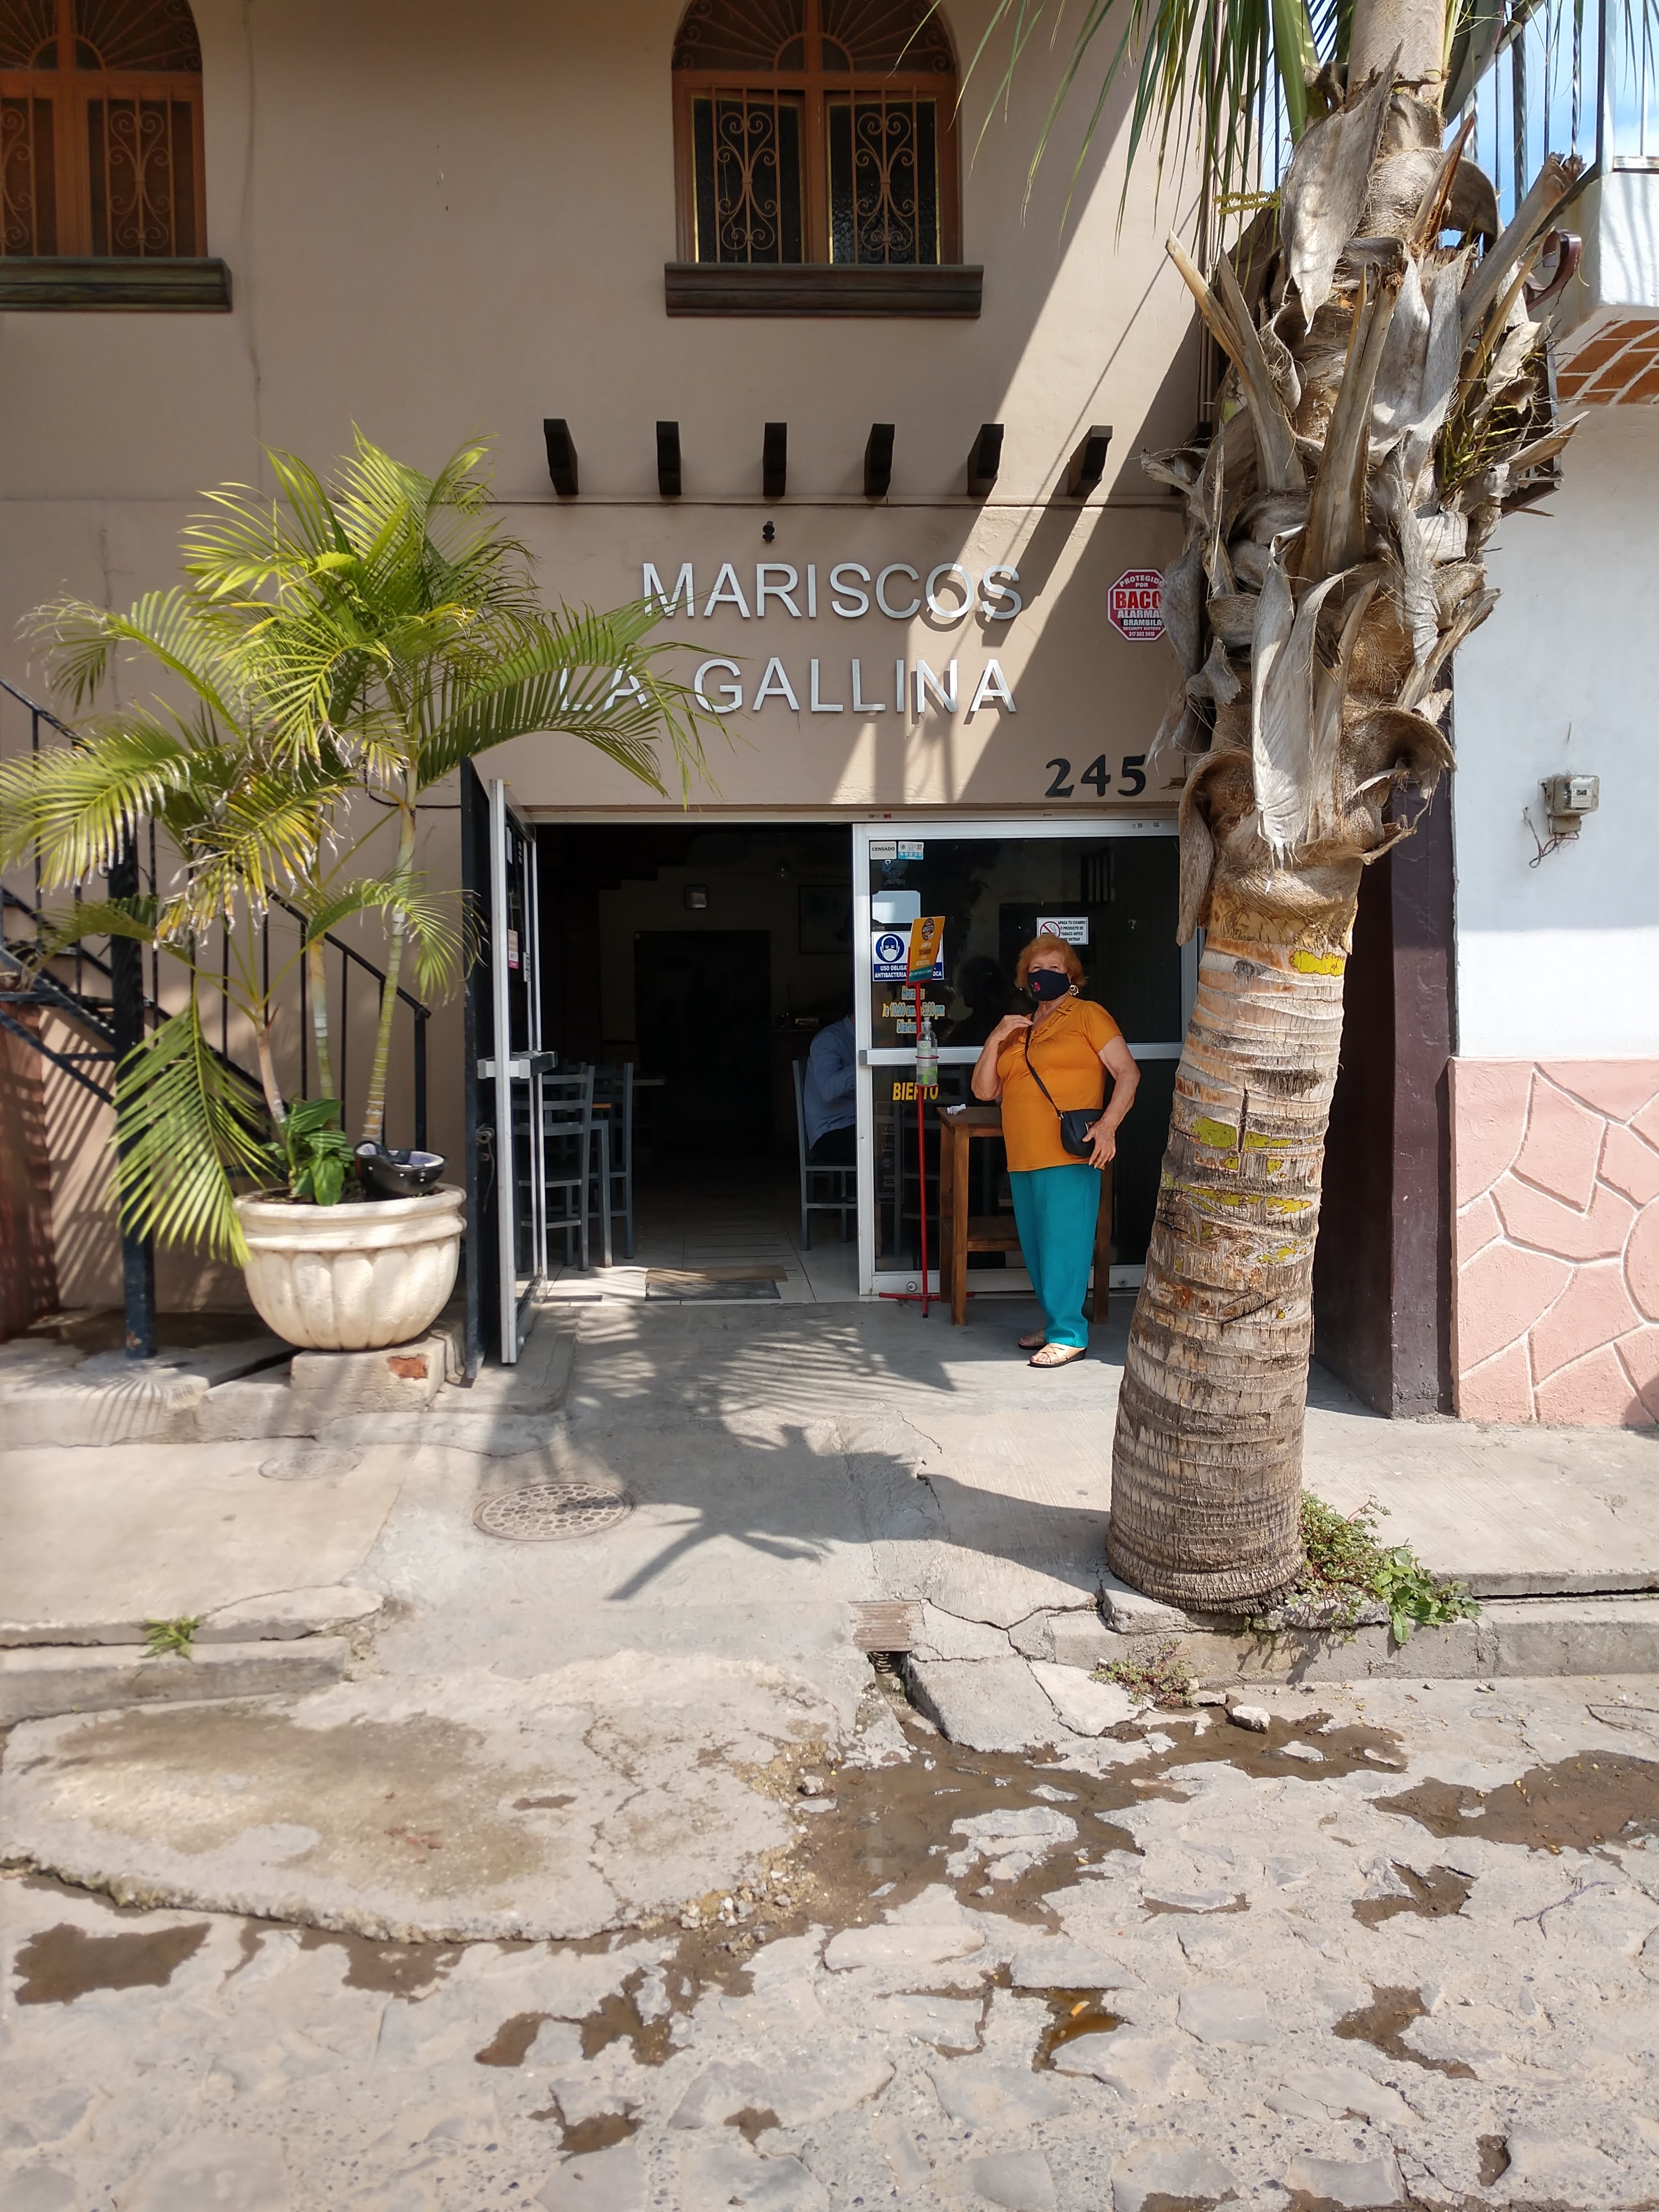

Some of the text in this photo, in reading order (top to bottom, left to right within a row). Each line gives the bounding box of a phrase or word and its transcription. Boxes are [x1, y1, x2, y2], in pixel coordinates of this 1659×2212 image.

[644, 563, 1022, 619] MARISCOS
[1119, 575, 1164, 587] PROTEGIDO
[1117, 610, 1162, 618] ALARMA
[560, 657, 1016, 713] LA GALLINA
[1045, 754, 1146, 798] 245
[935, 1005, 945, 1020] pm
